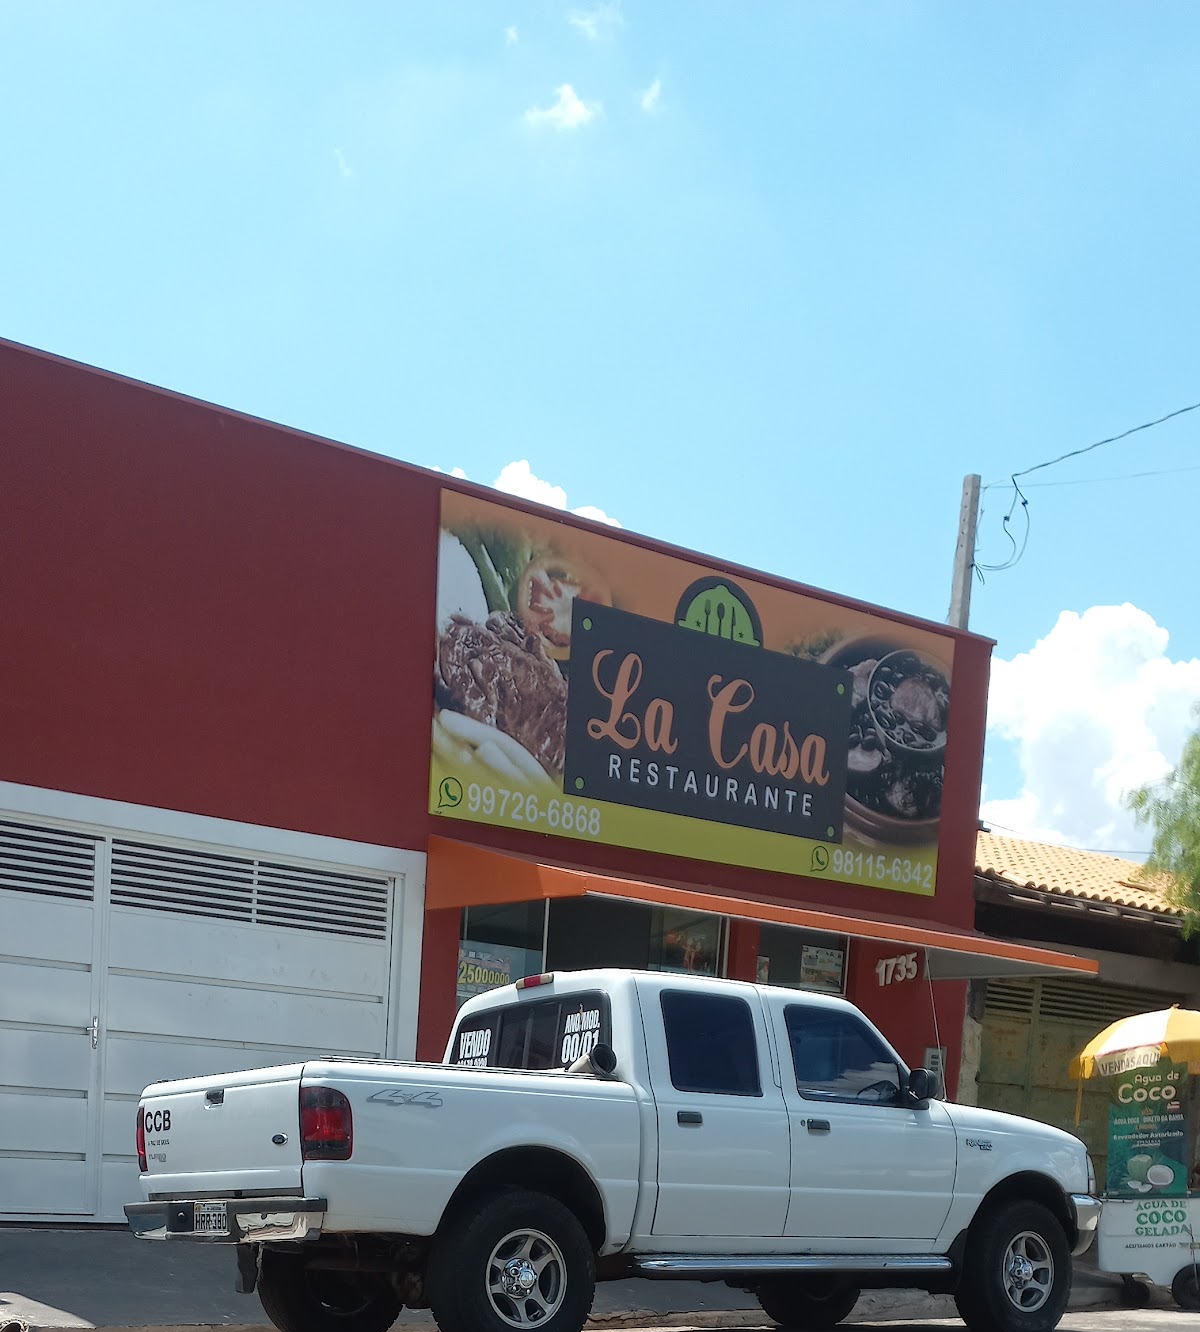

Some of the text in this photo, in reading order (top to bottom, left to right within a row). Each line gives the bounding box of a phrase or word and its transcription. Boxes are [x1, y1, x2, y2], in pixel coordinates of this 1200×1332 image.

[587, 649, 830, 787] La Casa
[608, 753, 813, 817] RESTAURANTE
[467, 783, 601, 836] 99726-6868
[833, 848, 933, 889] 98115-6342
[875, 952, 918, 987] 1735
[459, 1029, 491, 1059] VENDO
[562, 1030, 600, 1063] 00/01
[1167, 1070, 1180, 1080] de
[1118, 1083, 1176, 1103] Coco
[145, 1110, 171, 1133] CCB
[1136, 1210, 1187, 1225] COCO
[1171, 1200, 1187, 1208] DE
[1135, 1223, 1189, 1236] GELADA
